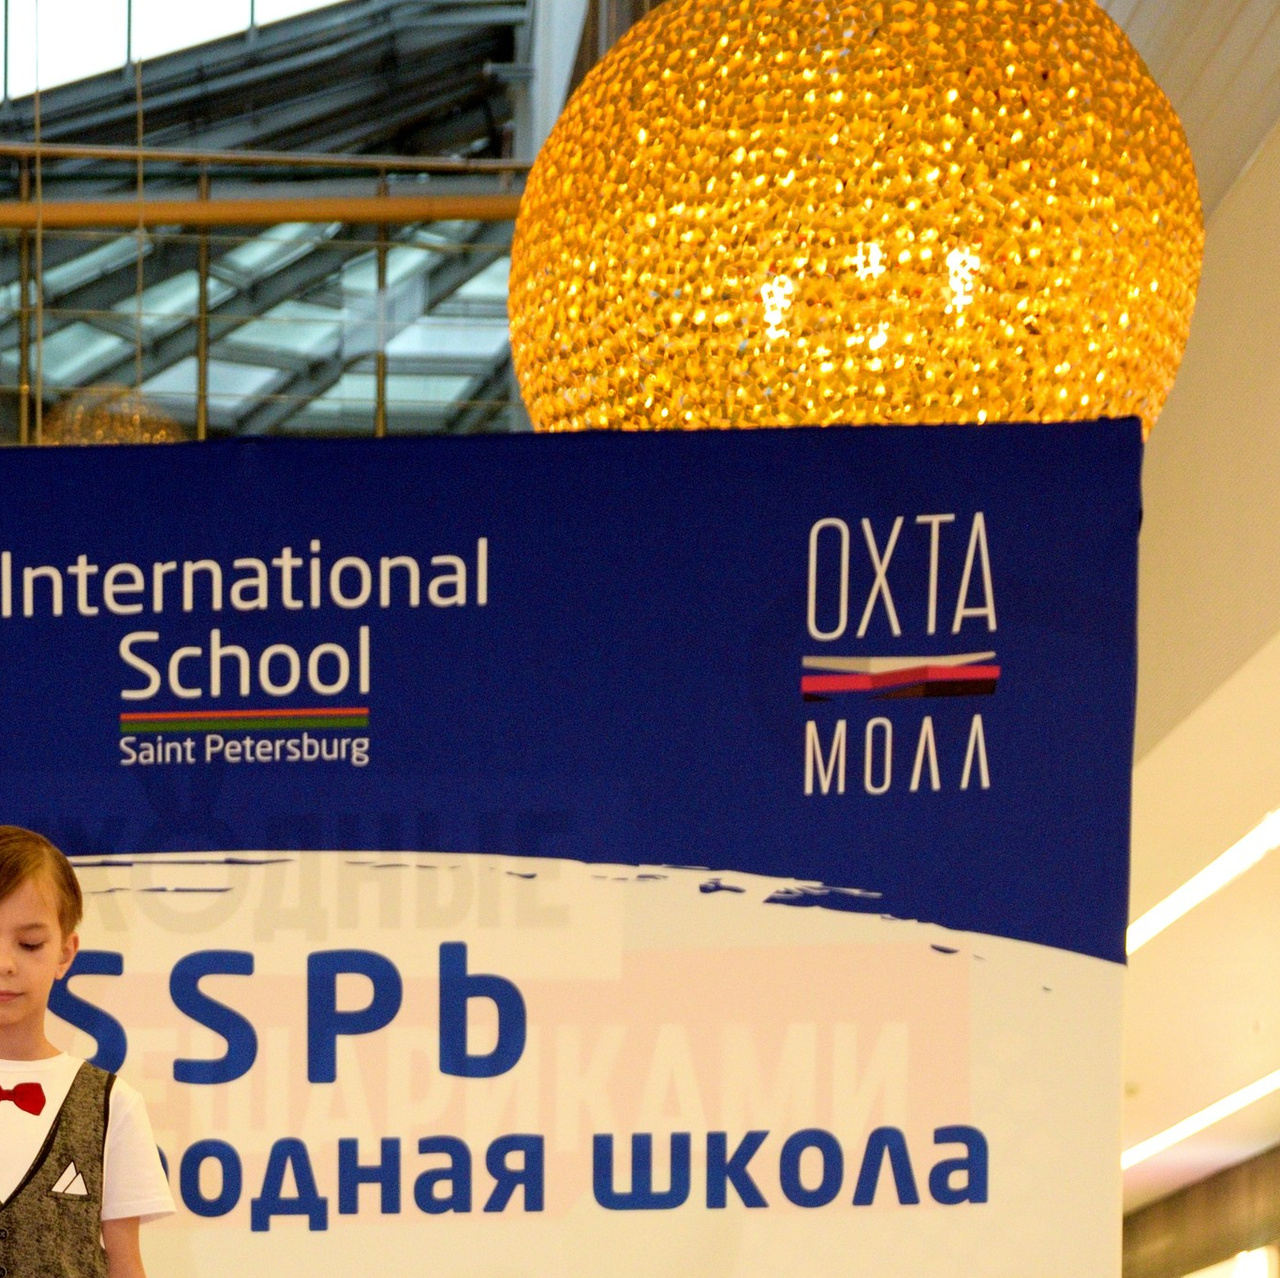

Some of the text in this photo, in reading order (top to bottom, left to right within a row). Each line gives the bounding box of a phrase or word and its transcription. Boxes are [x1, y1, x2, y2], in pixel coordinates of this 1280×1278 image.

[1, 537, 489, 619] International
[807, 511, 998, 641] ОХТА
[119, 625, 371, 700] School
[120, 732, 371, 767] Saint Petersburg
[804, 714, 991, 796] МОЛЛ
[592, 1125, 989, 1210] школа
